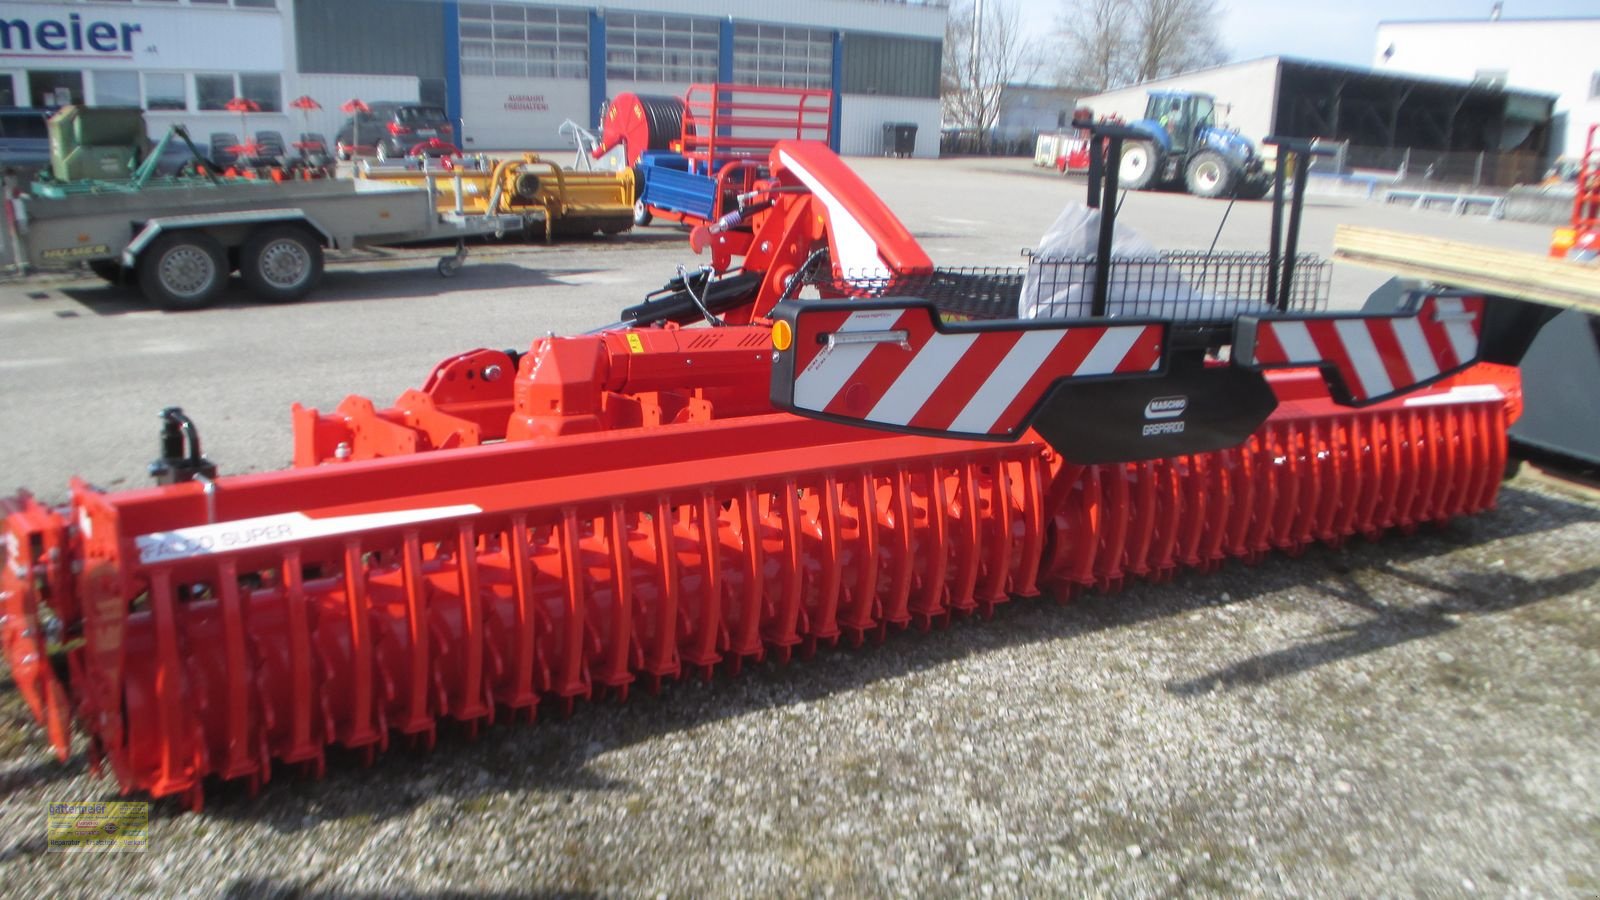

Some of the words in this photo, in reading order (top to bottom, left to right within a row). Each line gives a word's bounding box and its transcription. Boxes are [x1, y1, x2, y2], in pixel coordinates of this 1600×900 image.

[1150, 399, 1186, 411] MASCHIO
[1142, 421, 1185, 436] GASPARDO
[220, 524, 293, 546] SUPER
